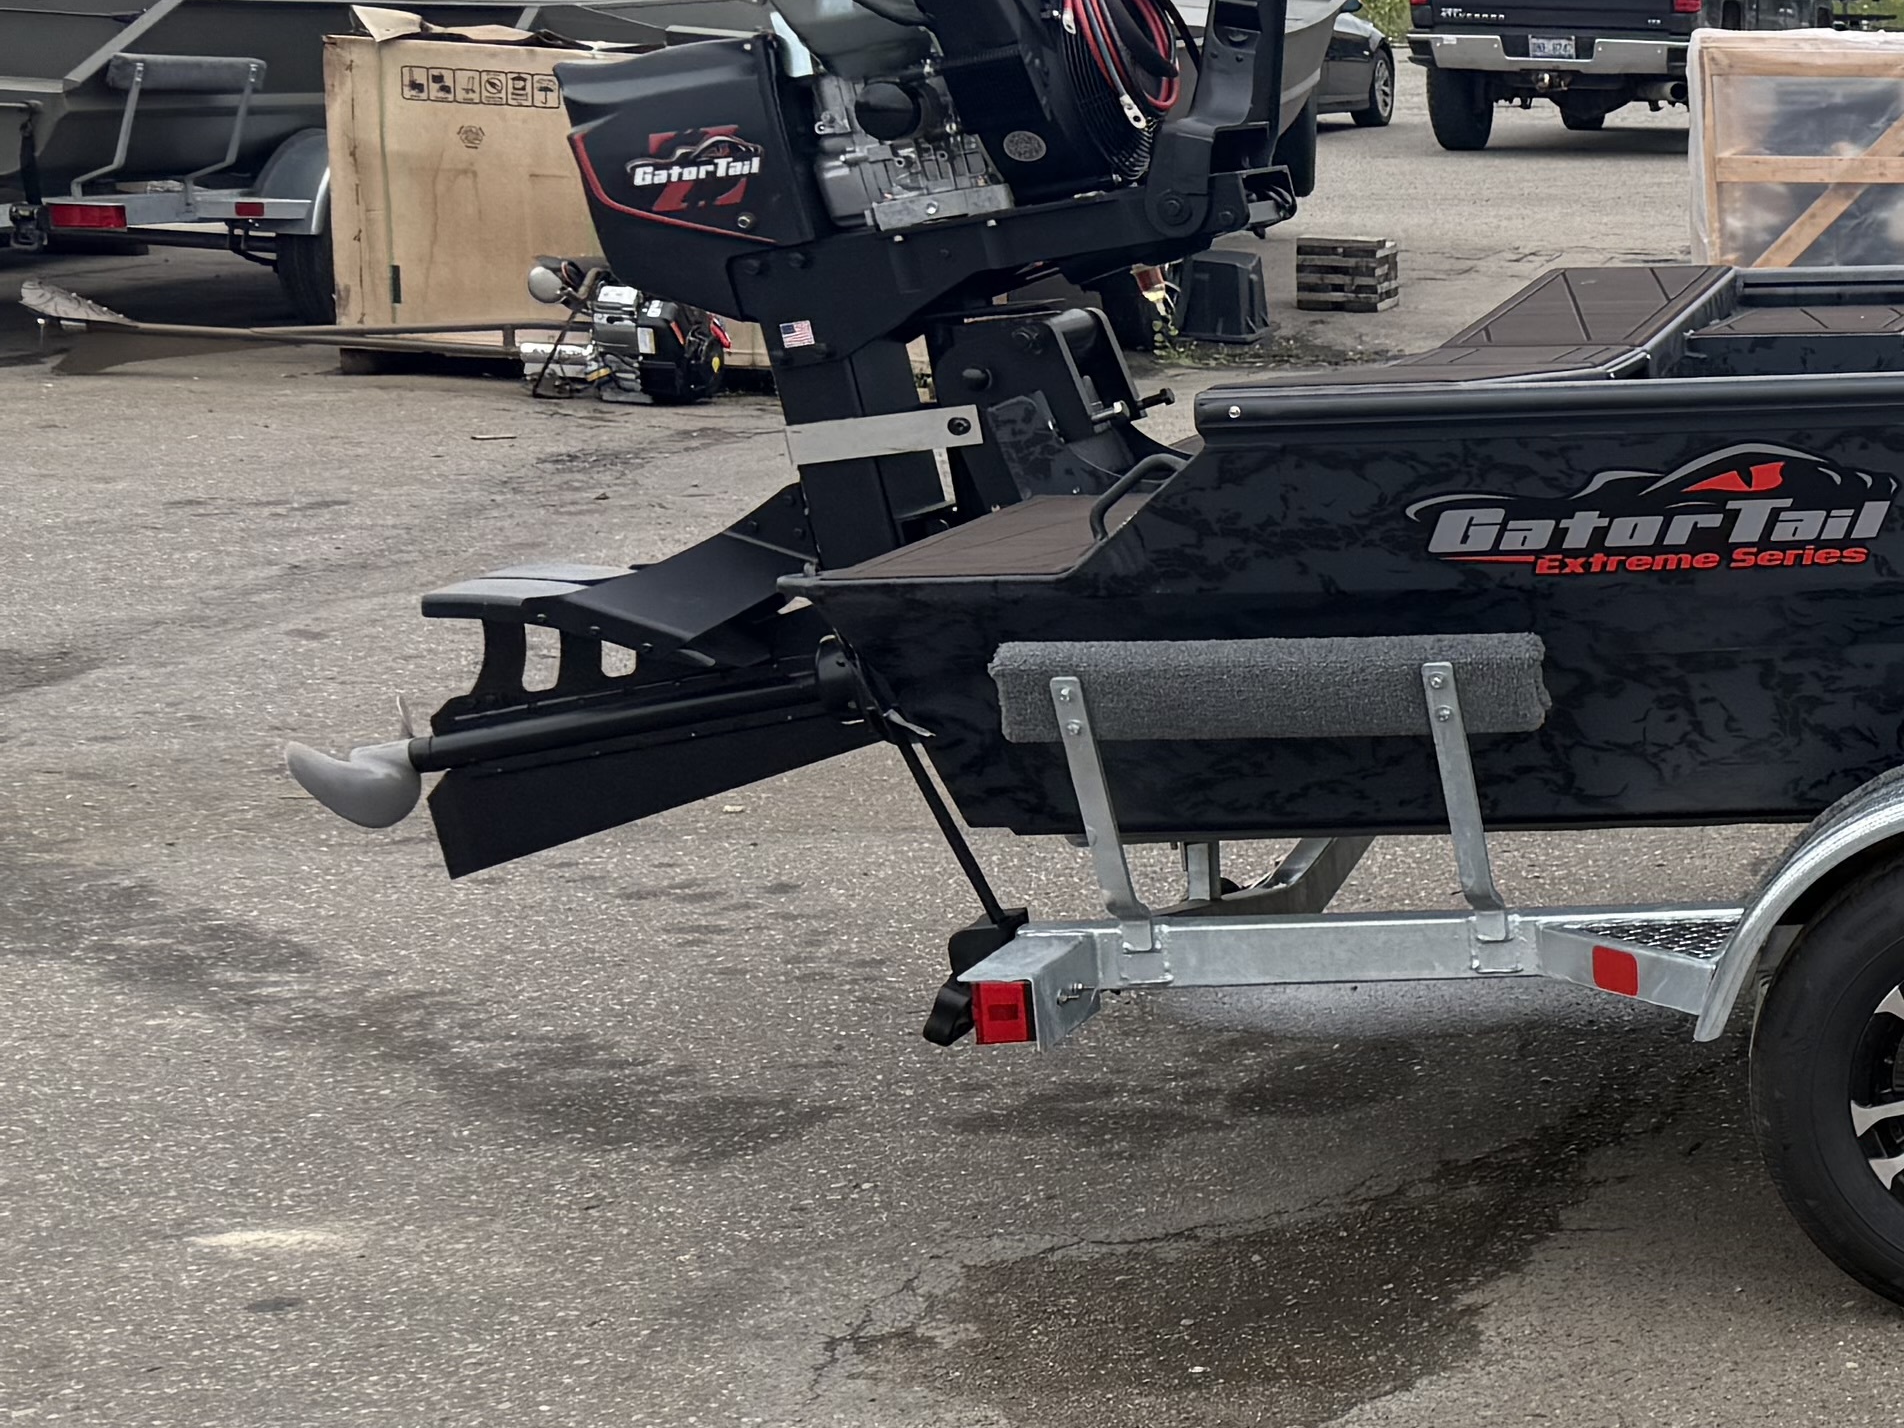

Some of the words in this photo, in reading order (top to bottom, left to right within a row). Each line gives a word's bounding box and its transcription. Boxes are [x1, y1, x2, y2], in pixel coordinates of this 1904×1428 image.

[633, 156, 761, 187] GatorTail
[1427, 498, 1892, 554] GatorTail
[1535, 549, 1720, 574] Extreme
[1729, 544, 1869, 569] Series
